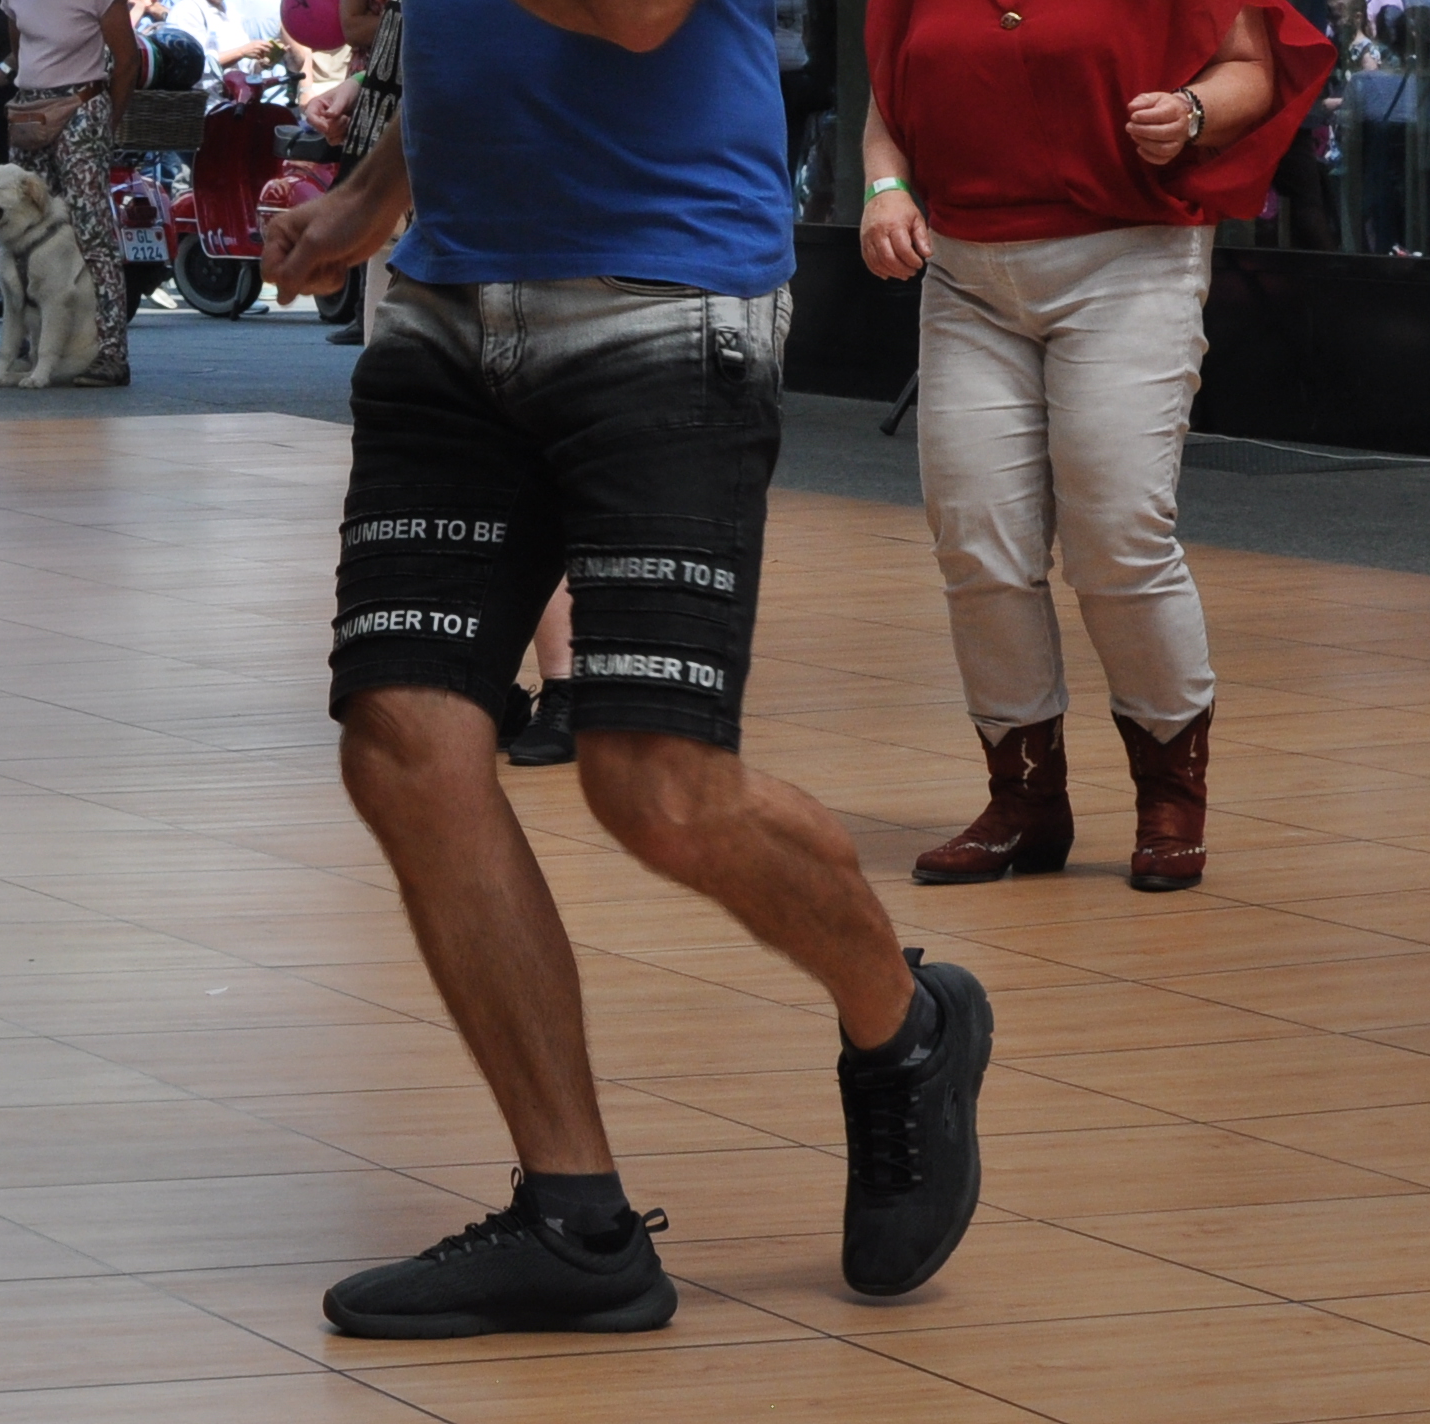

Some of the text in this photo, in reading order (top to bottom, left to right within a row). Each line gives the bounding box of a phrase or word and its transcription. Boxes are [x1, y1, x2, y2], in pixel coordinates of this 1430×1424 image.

[136, 229, 152, 244] GL
[132, 246, 163, 260] 2124
[345, 518, 507, 548] NUMBER TO BE
[585, 557, 677, 580] NUMBER
[681, 560, 711, 586] TO
[339, 610, 422, 643] NUMBER
[430, 612, 462, 634] TO
[586, 654, 682, 681] NUMBER
[686, 660, 714, 690] TO
